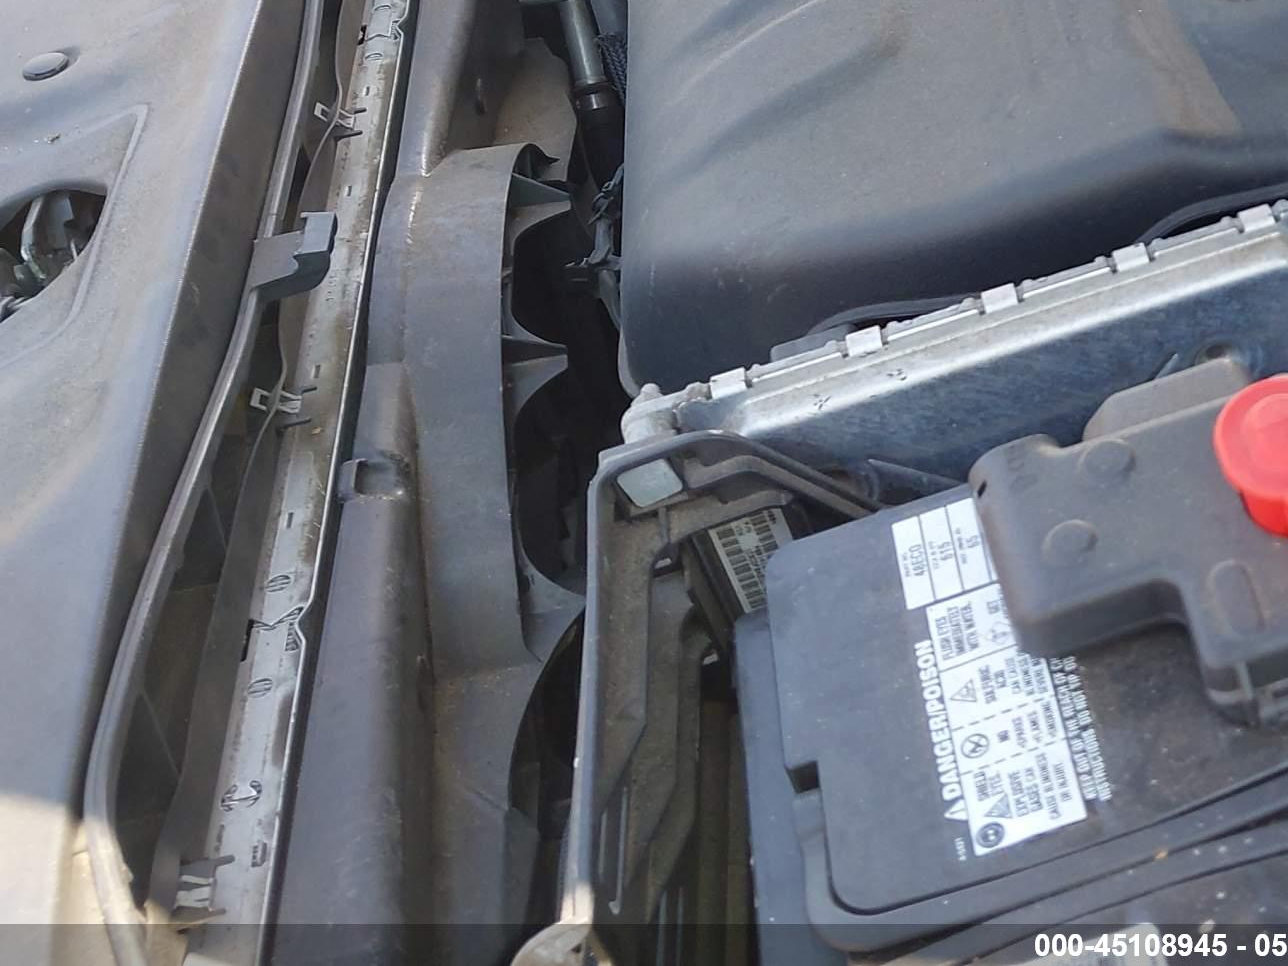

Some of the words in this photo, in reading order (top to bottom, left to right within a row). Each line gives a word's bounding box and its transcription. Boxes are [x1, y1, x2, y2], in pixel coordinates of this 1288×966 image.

[934, 615, 948, 636] EYES
[946, 604, 966, 656] IMMEDIATELY
[913, 638, 962, 803] DANGER/POISON
